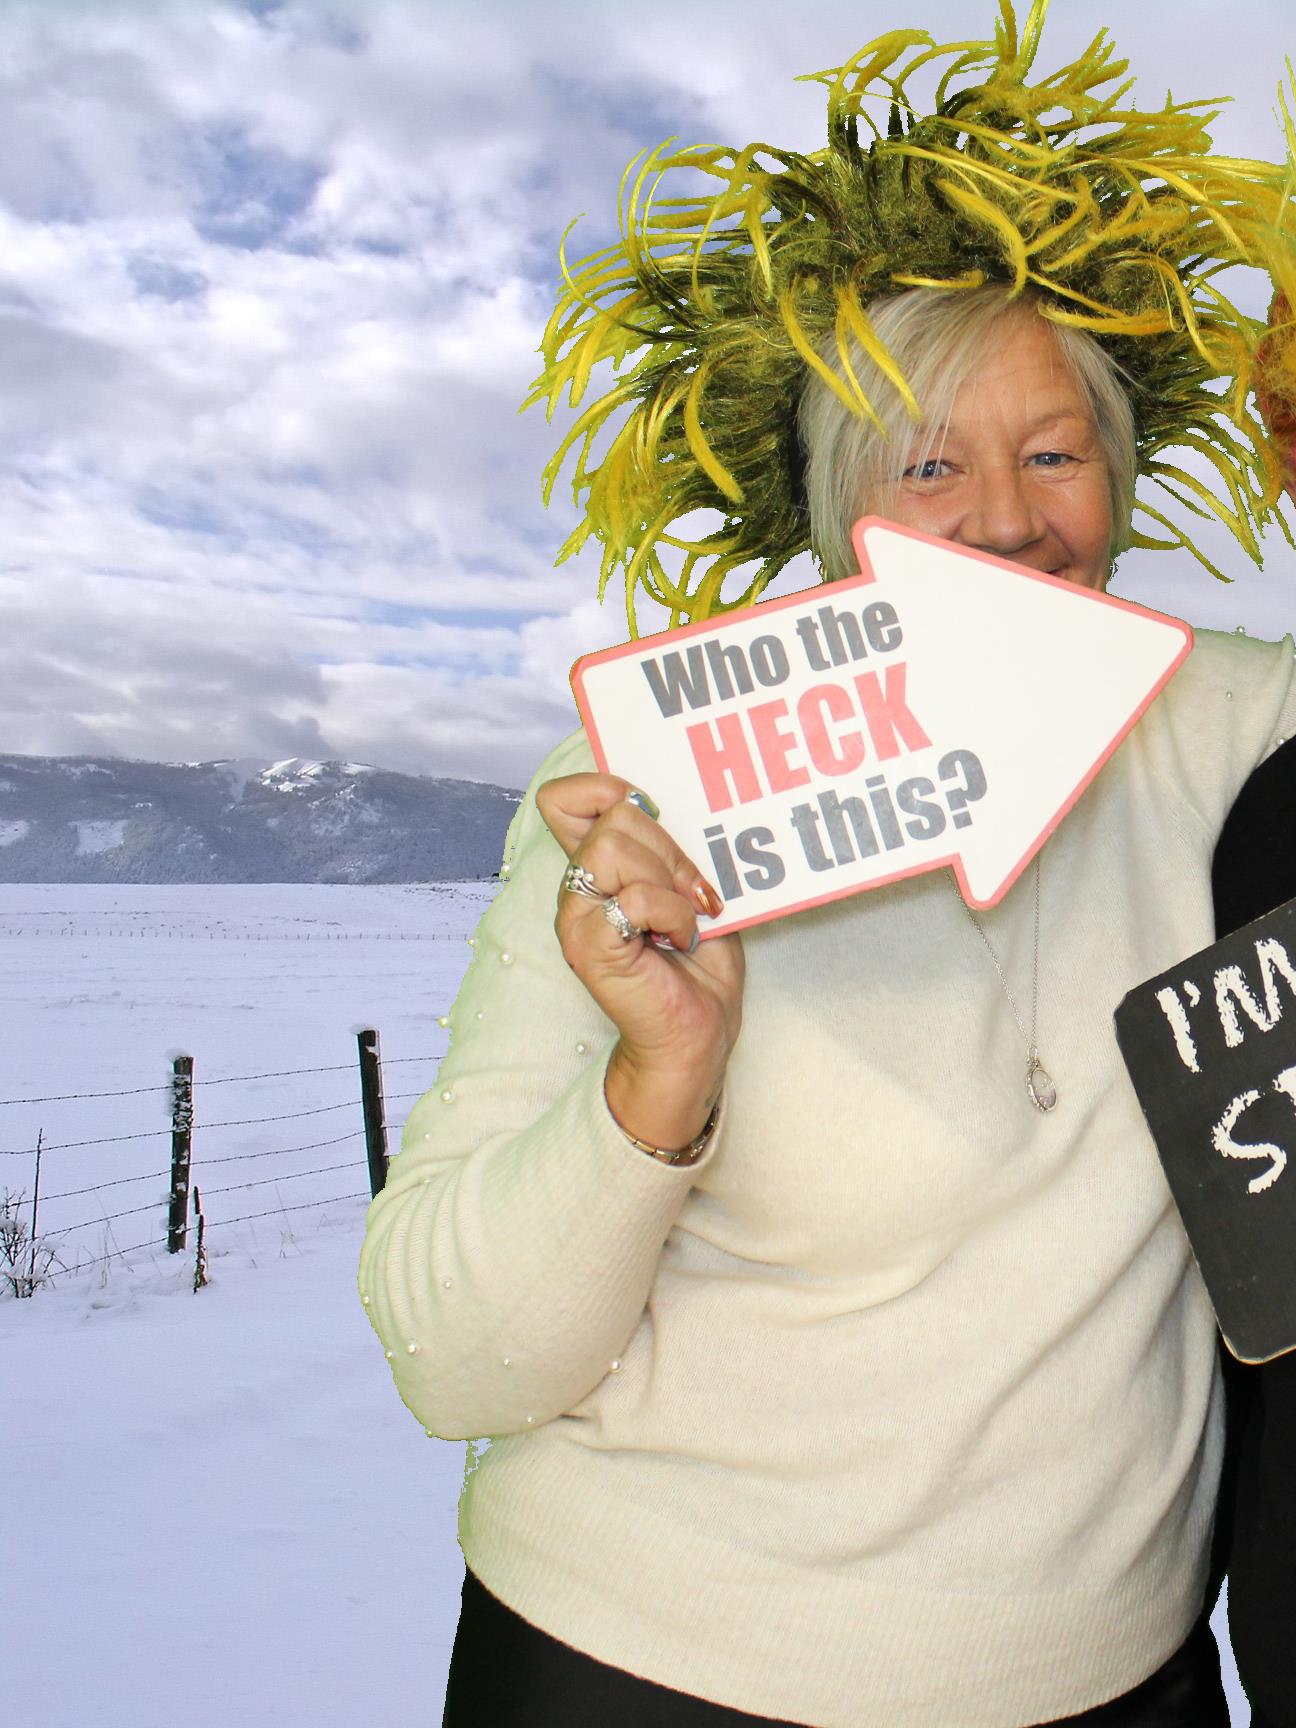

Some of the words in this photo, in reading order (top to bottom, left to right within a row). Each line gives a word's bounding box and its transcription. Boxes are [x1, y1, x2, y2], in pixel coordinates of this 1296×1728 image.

[642, 635, 790, 718] Who
[797, 602, 902, 671] the
[687, 662, 932, 812] HECK
[704, 825, 786, 901] is
[790, 750, 987, 871] this?
